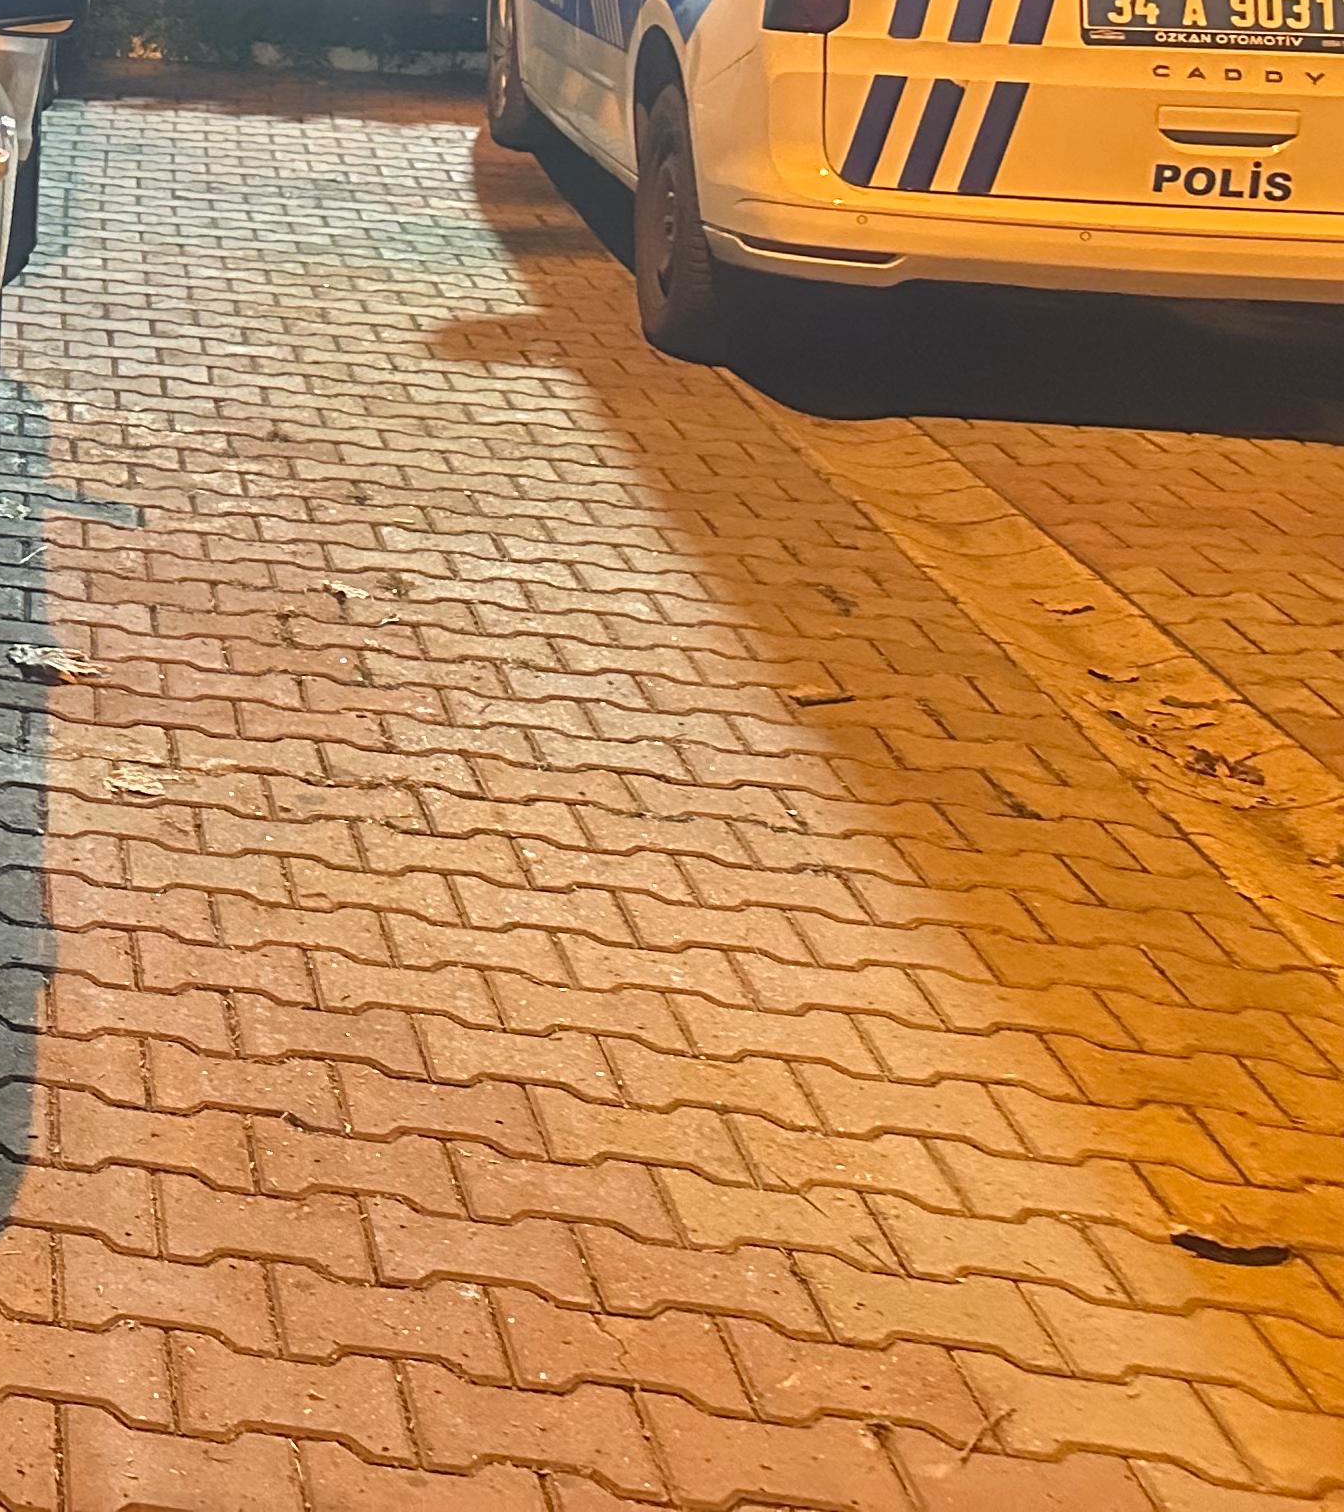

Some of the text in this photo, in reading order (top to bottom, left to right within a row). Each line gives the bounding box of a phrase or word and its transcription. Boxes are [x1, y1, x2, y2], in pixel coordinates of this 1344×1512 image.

[1215, 34, 1304, 47] OTOMOTİV
[1152, 64, 1326, 85] CADDY
[1152, 160, 1293, 202] POLİS
